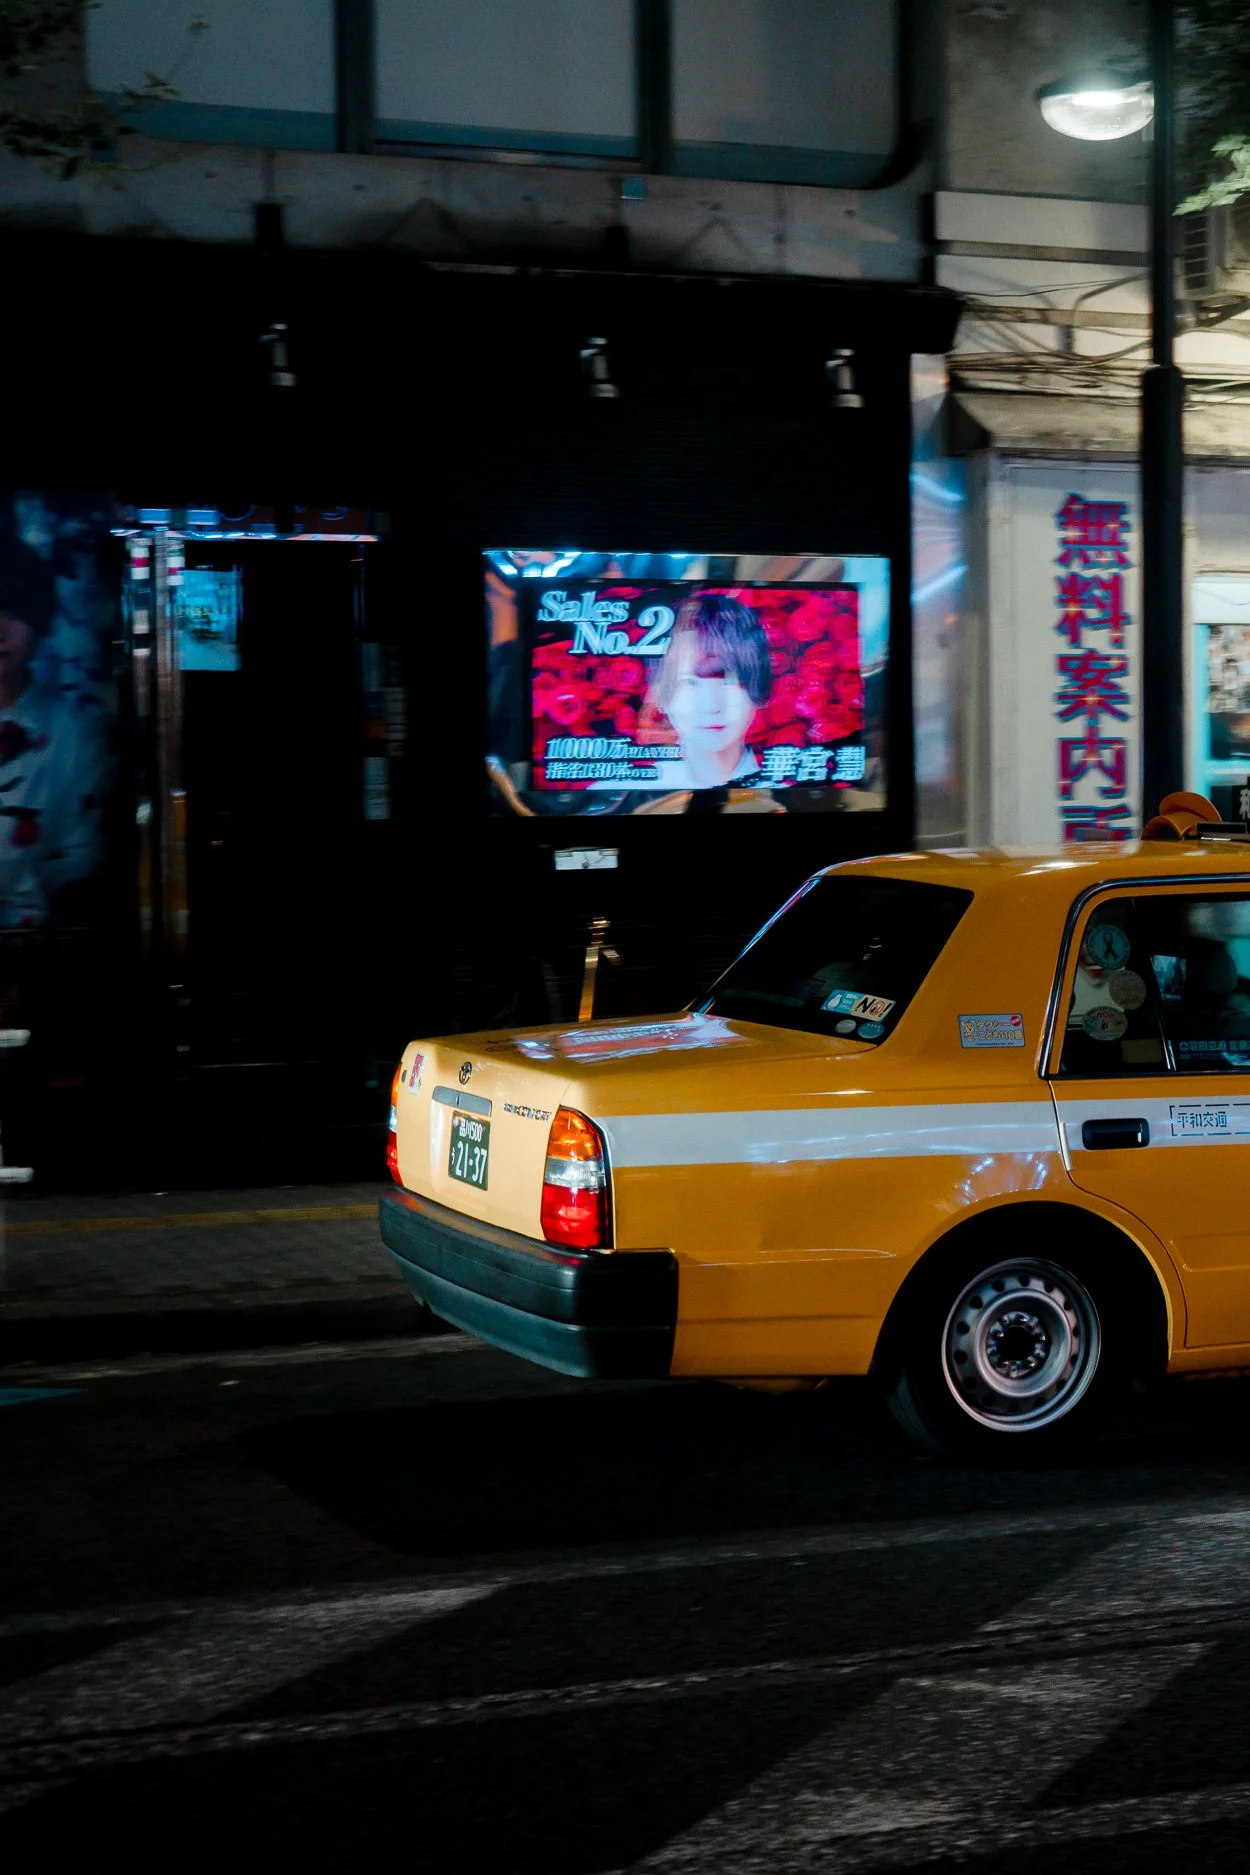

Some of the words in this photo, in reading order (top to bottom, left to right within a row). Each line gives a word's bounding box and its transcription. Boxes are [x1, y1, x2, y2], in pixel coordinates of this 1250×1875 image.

[536, 589, 629, 622] Sales
[1177, 1111, 1228, 1129] 平和交通
[455, 1140, 488, 1185] 21-37
